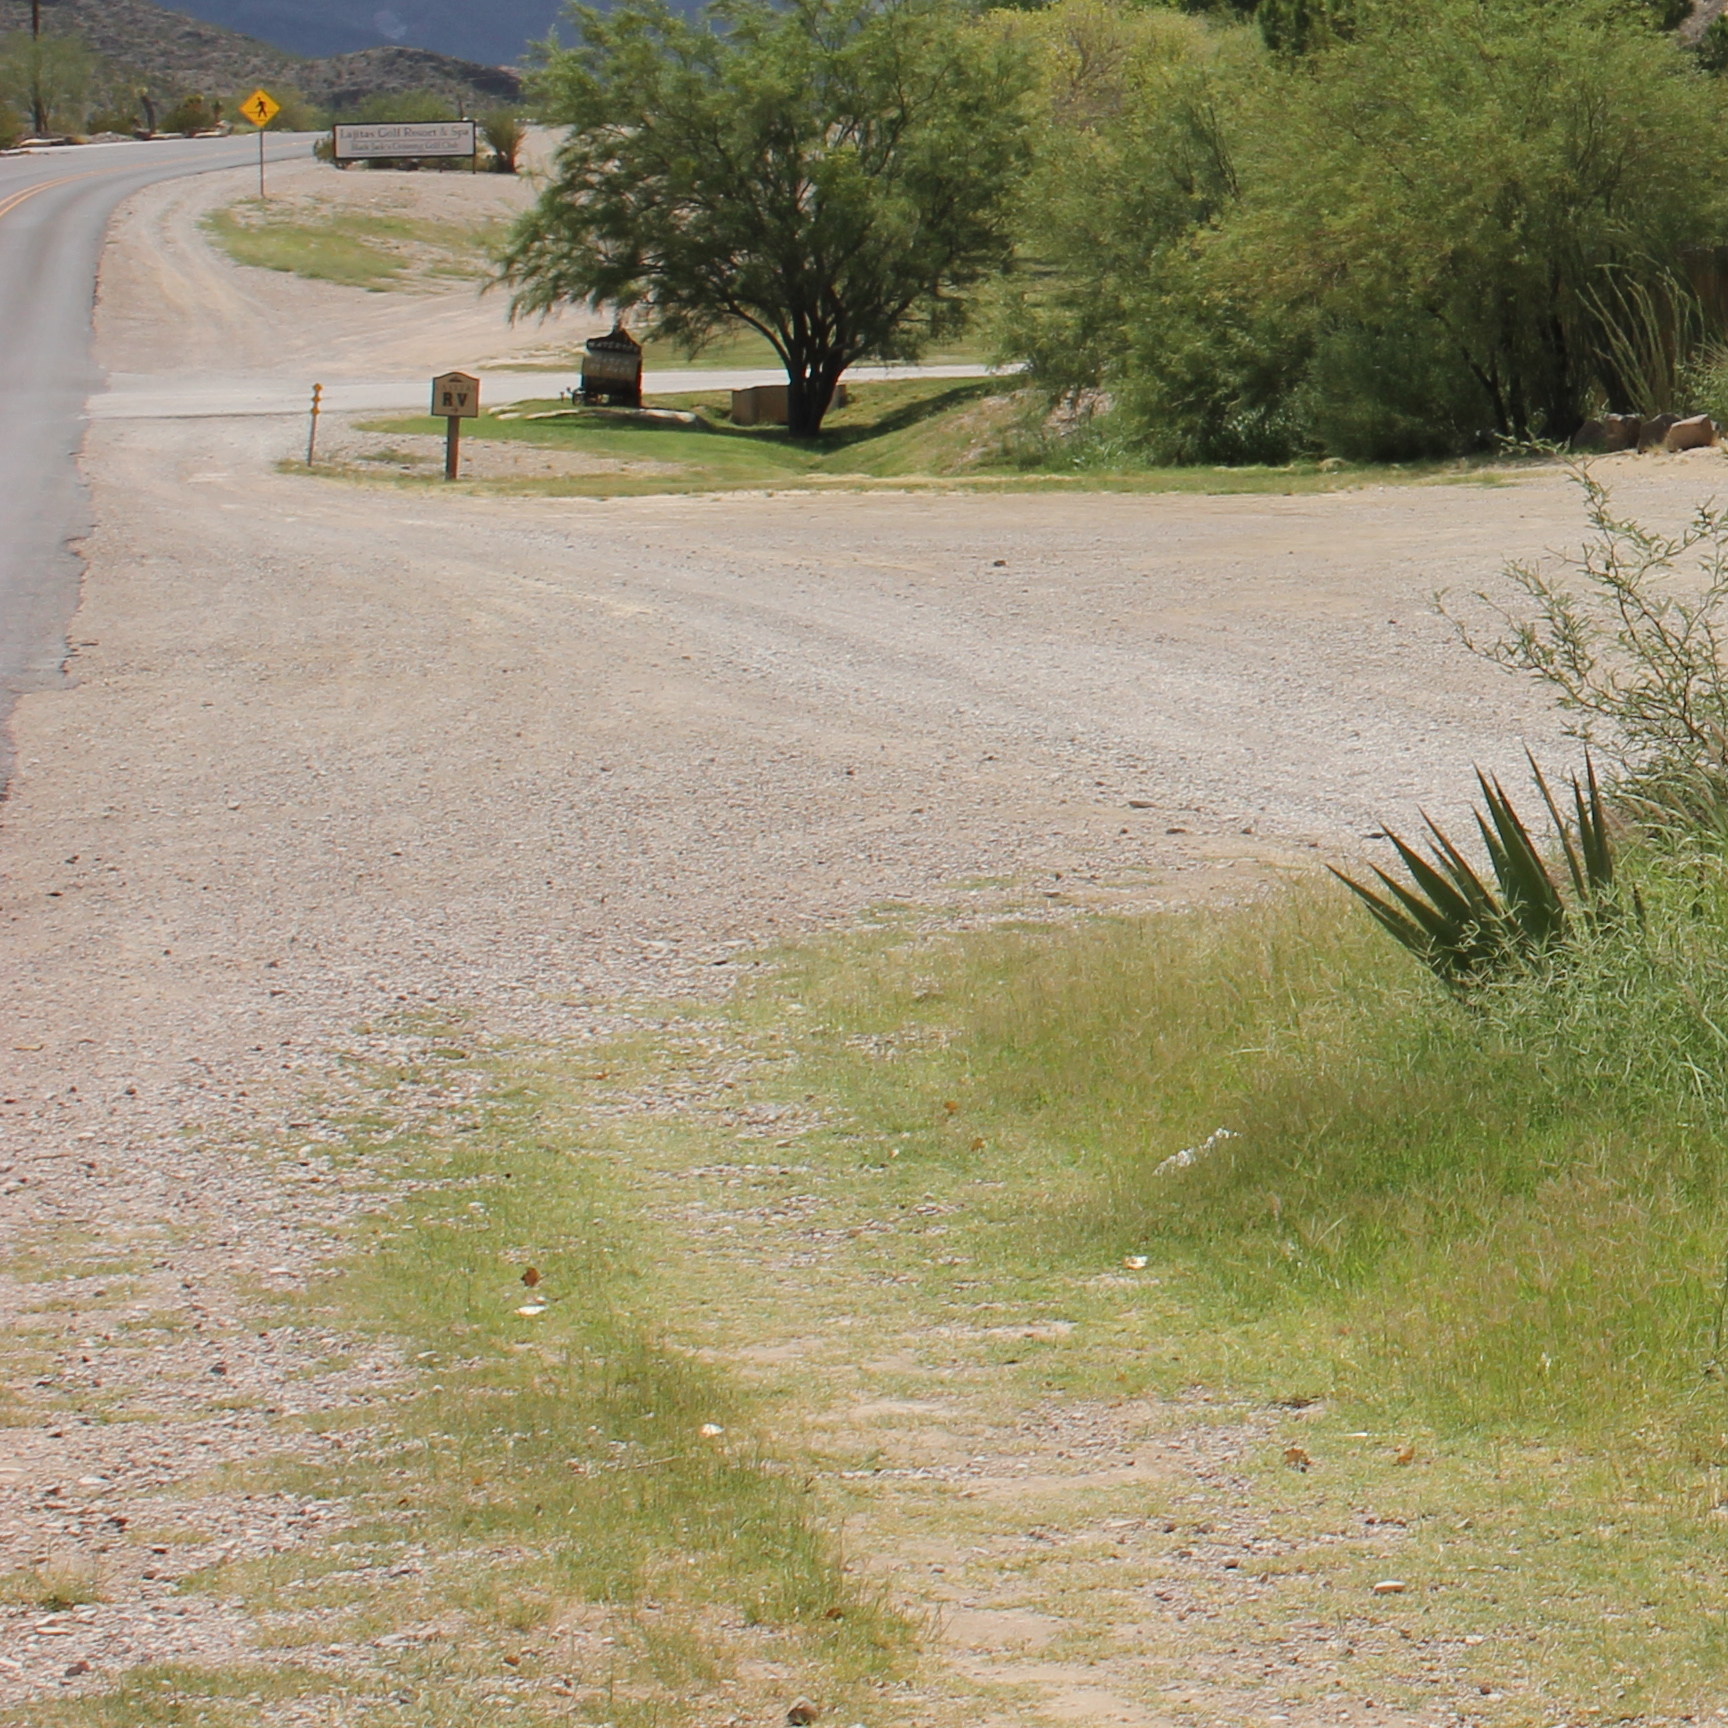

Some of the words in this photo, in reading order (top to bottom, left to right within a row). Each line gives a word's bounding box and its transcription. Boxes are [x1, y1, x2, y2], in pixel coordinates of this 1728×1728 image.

[339, 128, 375, 140] Lajitas
[378, 127, 401, 138] Golf
[404, 127, 436, 137] Resort
[451, 126, 469, 140] Spa
[442, 391, 469, 407] RV
